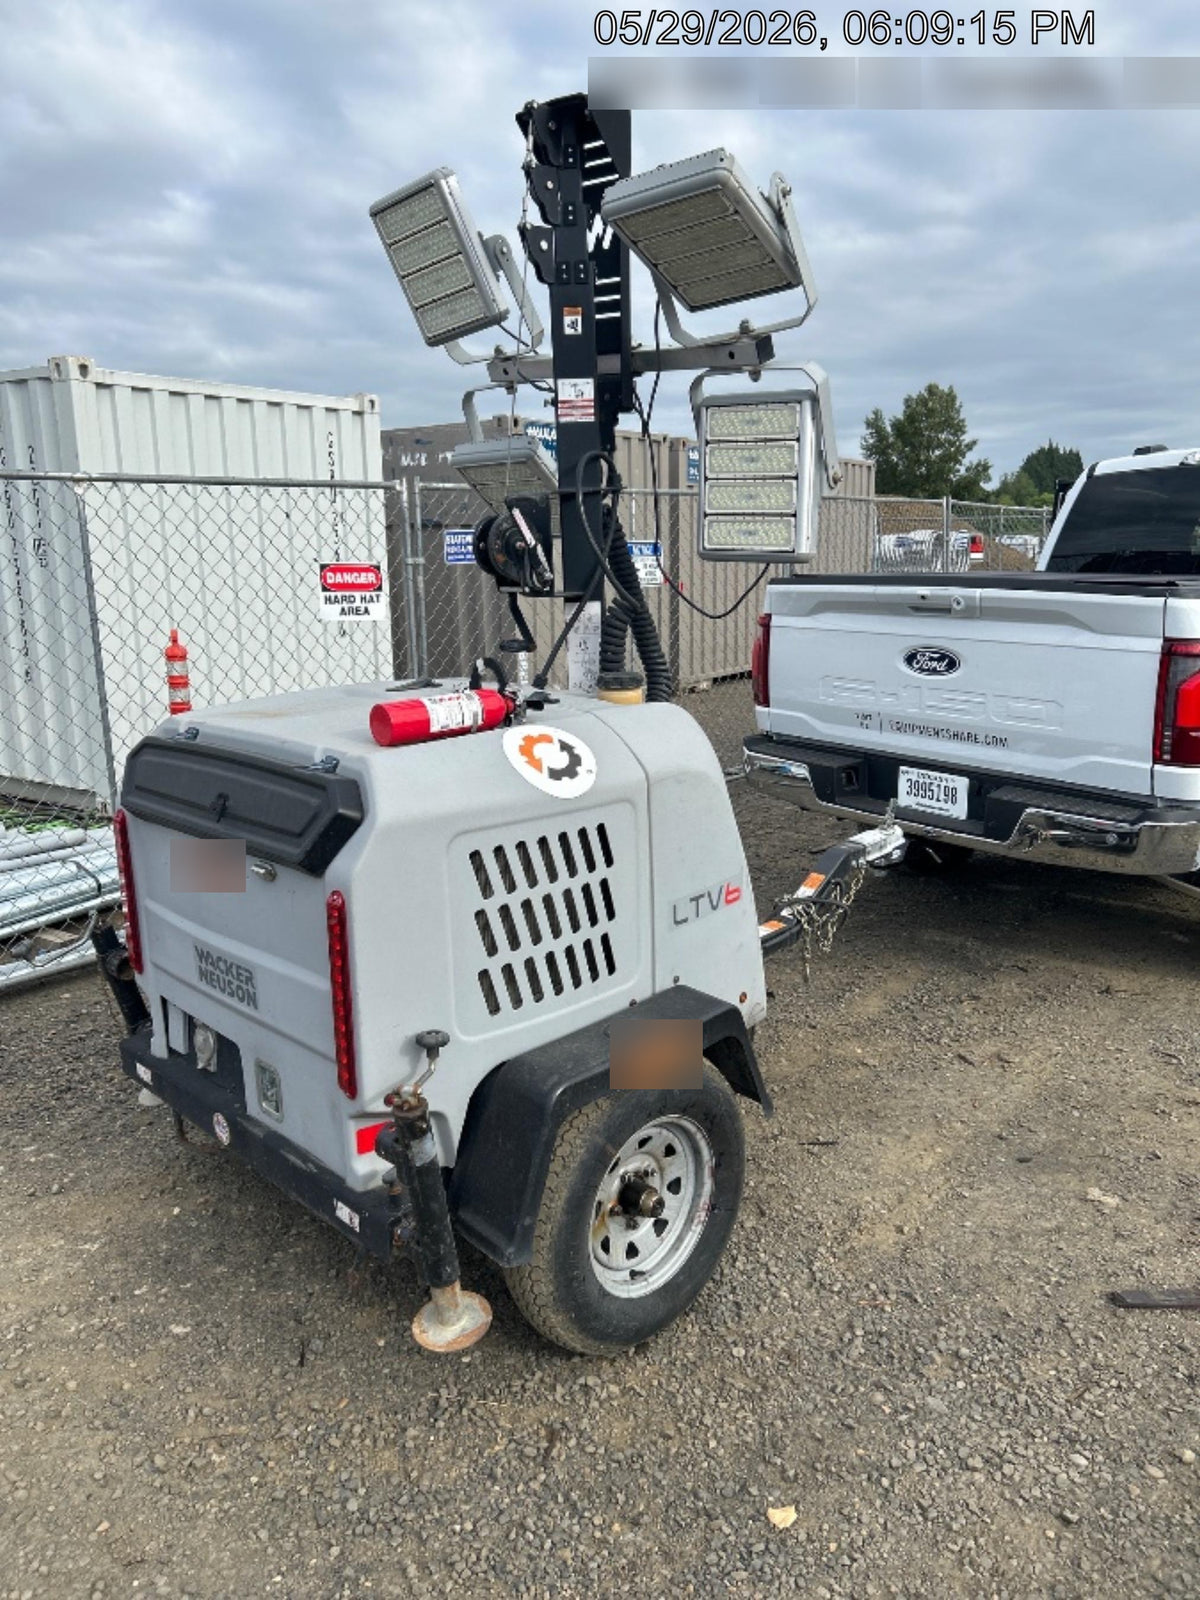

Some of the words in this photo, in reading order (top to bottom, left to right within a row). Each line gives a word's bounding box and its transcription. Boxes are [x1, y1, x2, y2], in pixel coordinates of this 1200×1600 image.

[326, 572, 377, 585] DANGER
[324, 593, 357, 606] HARD
[360, 593, 381, 604] HAT
[339, 606, 370, 617] AREA
[913, 651, 950, 672] Ford
[673, 882, 741, 926] LTV6
[195, 946, 255, 989] WACKER
[198, 965, 258, 1011] NEUSON
